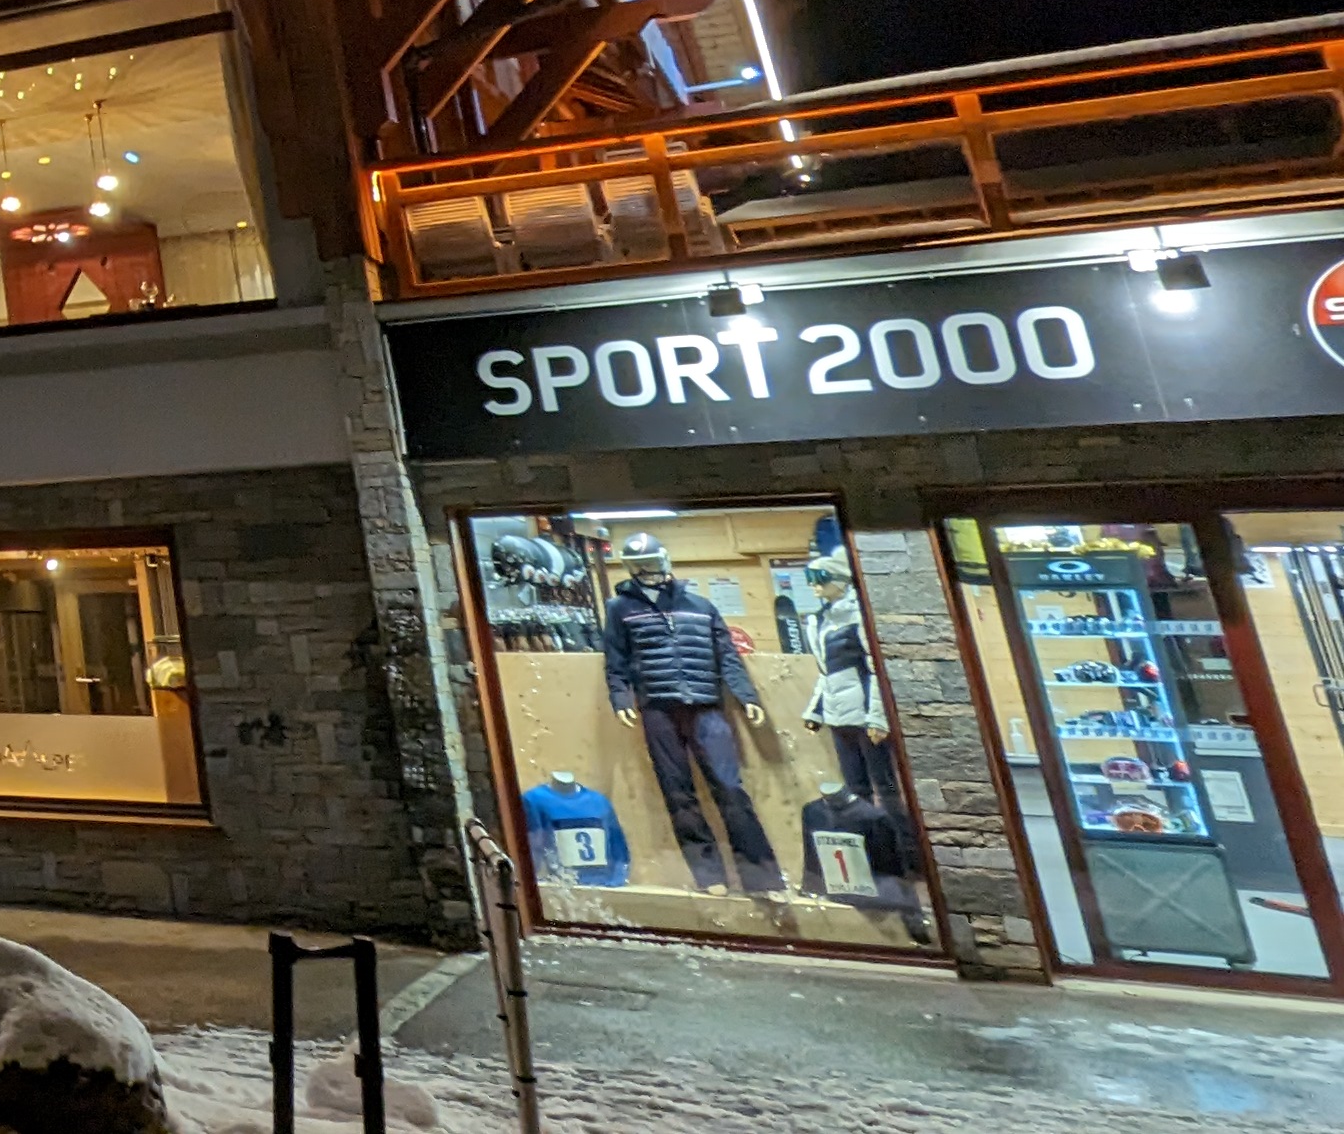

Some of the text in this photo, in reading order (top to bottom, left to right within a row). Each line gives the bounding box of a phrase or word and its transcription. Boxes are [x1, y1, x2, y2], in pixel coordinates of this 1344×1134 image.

[475, 305, 1097, 417] SPORT 2000
[574, 831, 596, 862] 3
[833, 849, 850, 884] 1
